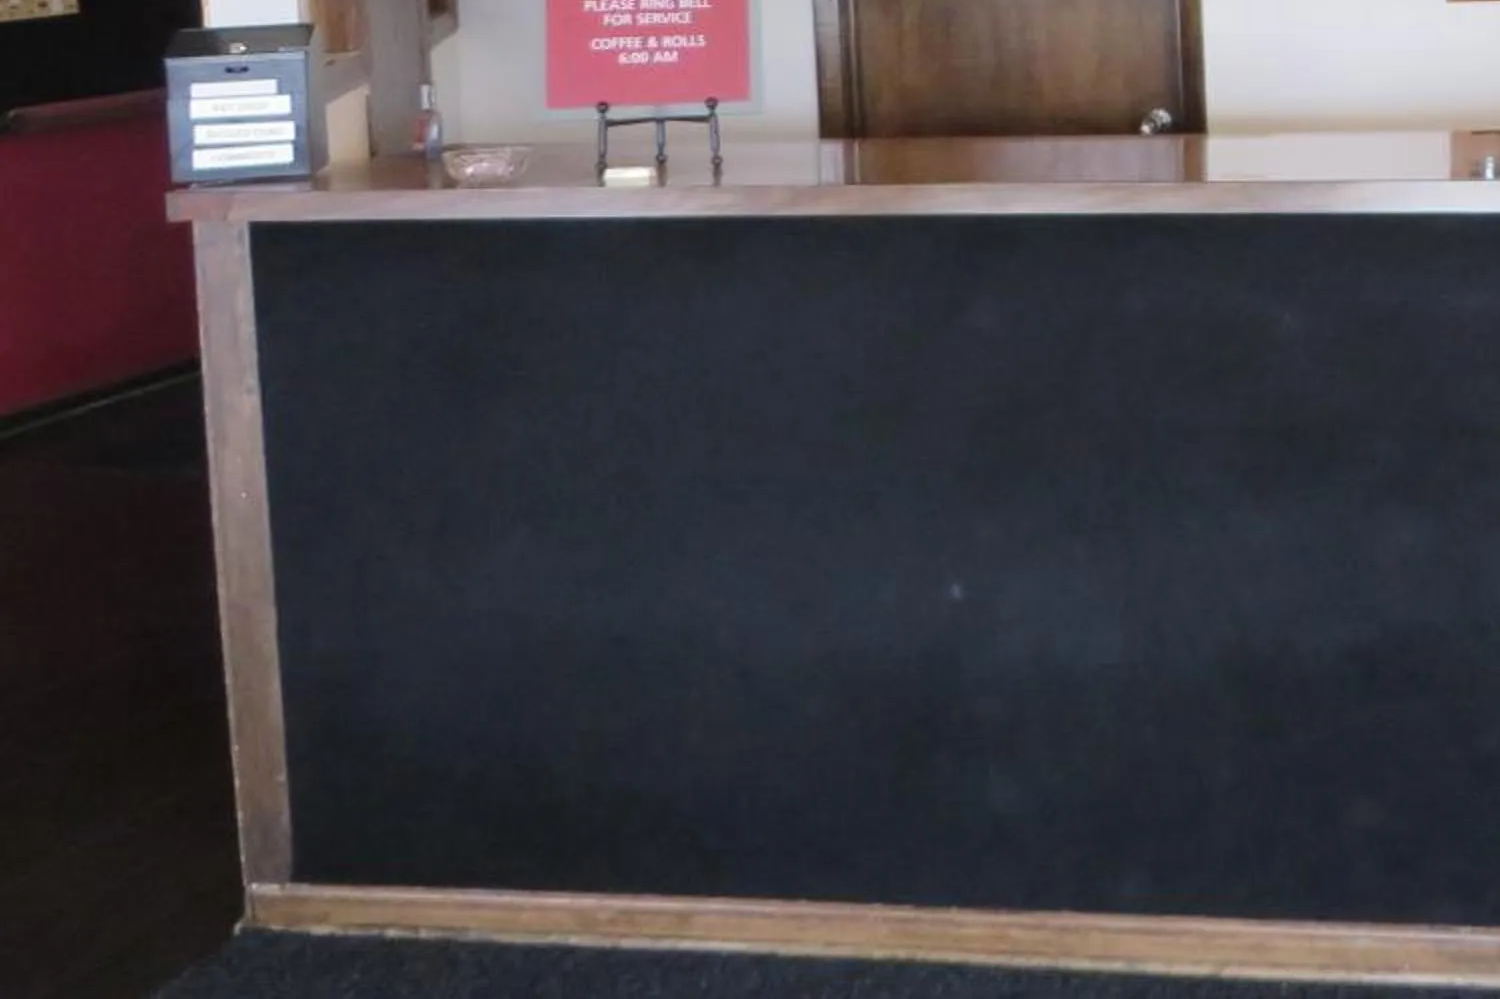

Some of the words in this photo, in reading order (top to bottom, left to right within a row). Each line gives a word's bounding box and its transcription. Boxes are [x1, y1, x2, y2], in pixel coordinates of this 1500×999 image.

[603, 13, 633, 26] FOR
[636, 11, 692, 26] SERVICE
[590, 36, 643, 50] COFFEE
[646, 36, 659, 49] &
[662, 34, 707, 48] ROLLS
[617, 52, 650, 65] 6:00
[652, 50, 679, 63] AM
